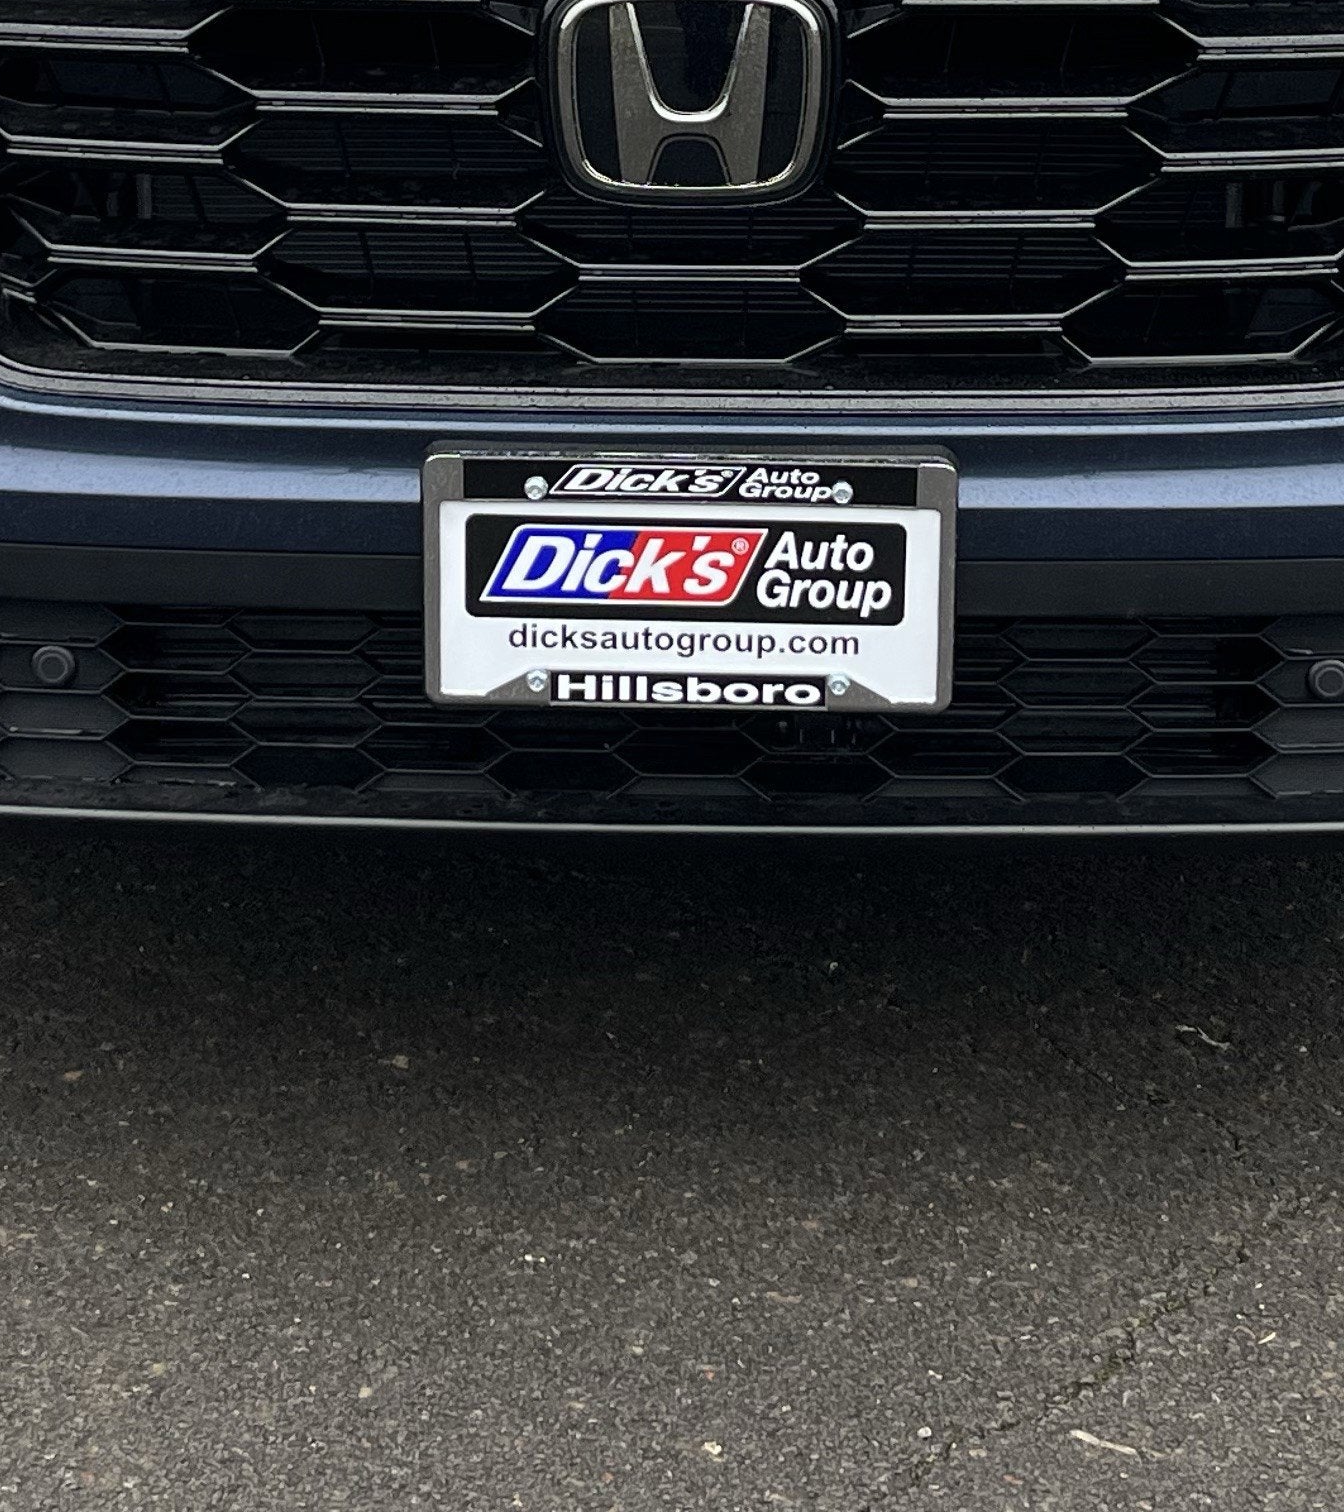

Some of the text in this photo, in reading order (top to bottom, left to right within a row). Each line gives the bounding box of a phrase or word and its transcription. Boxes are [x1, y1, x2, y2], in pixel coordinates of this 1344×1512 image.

[738, 481, 833, 503] Group
[745, 467, 821, 485] Auto
[763, 531, 875, 572] Auto
[756, 568, 892, 618] Group
[508, 622, 860, 659] dicksautogroup.com
[556, 673, 822, 705] Hillsboro
